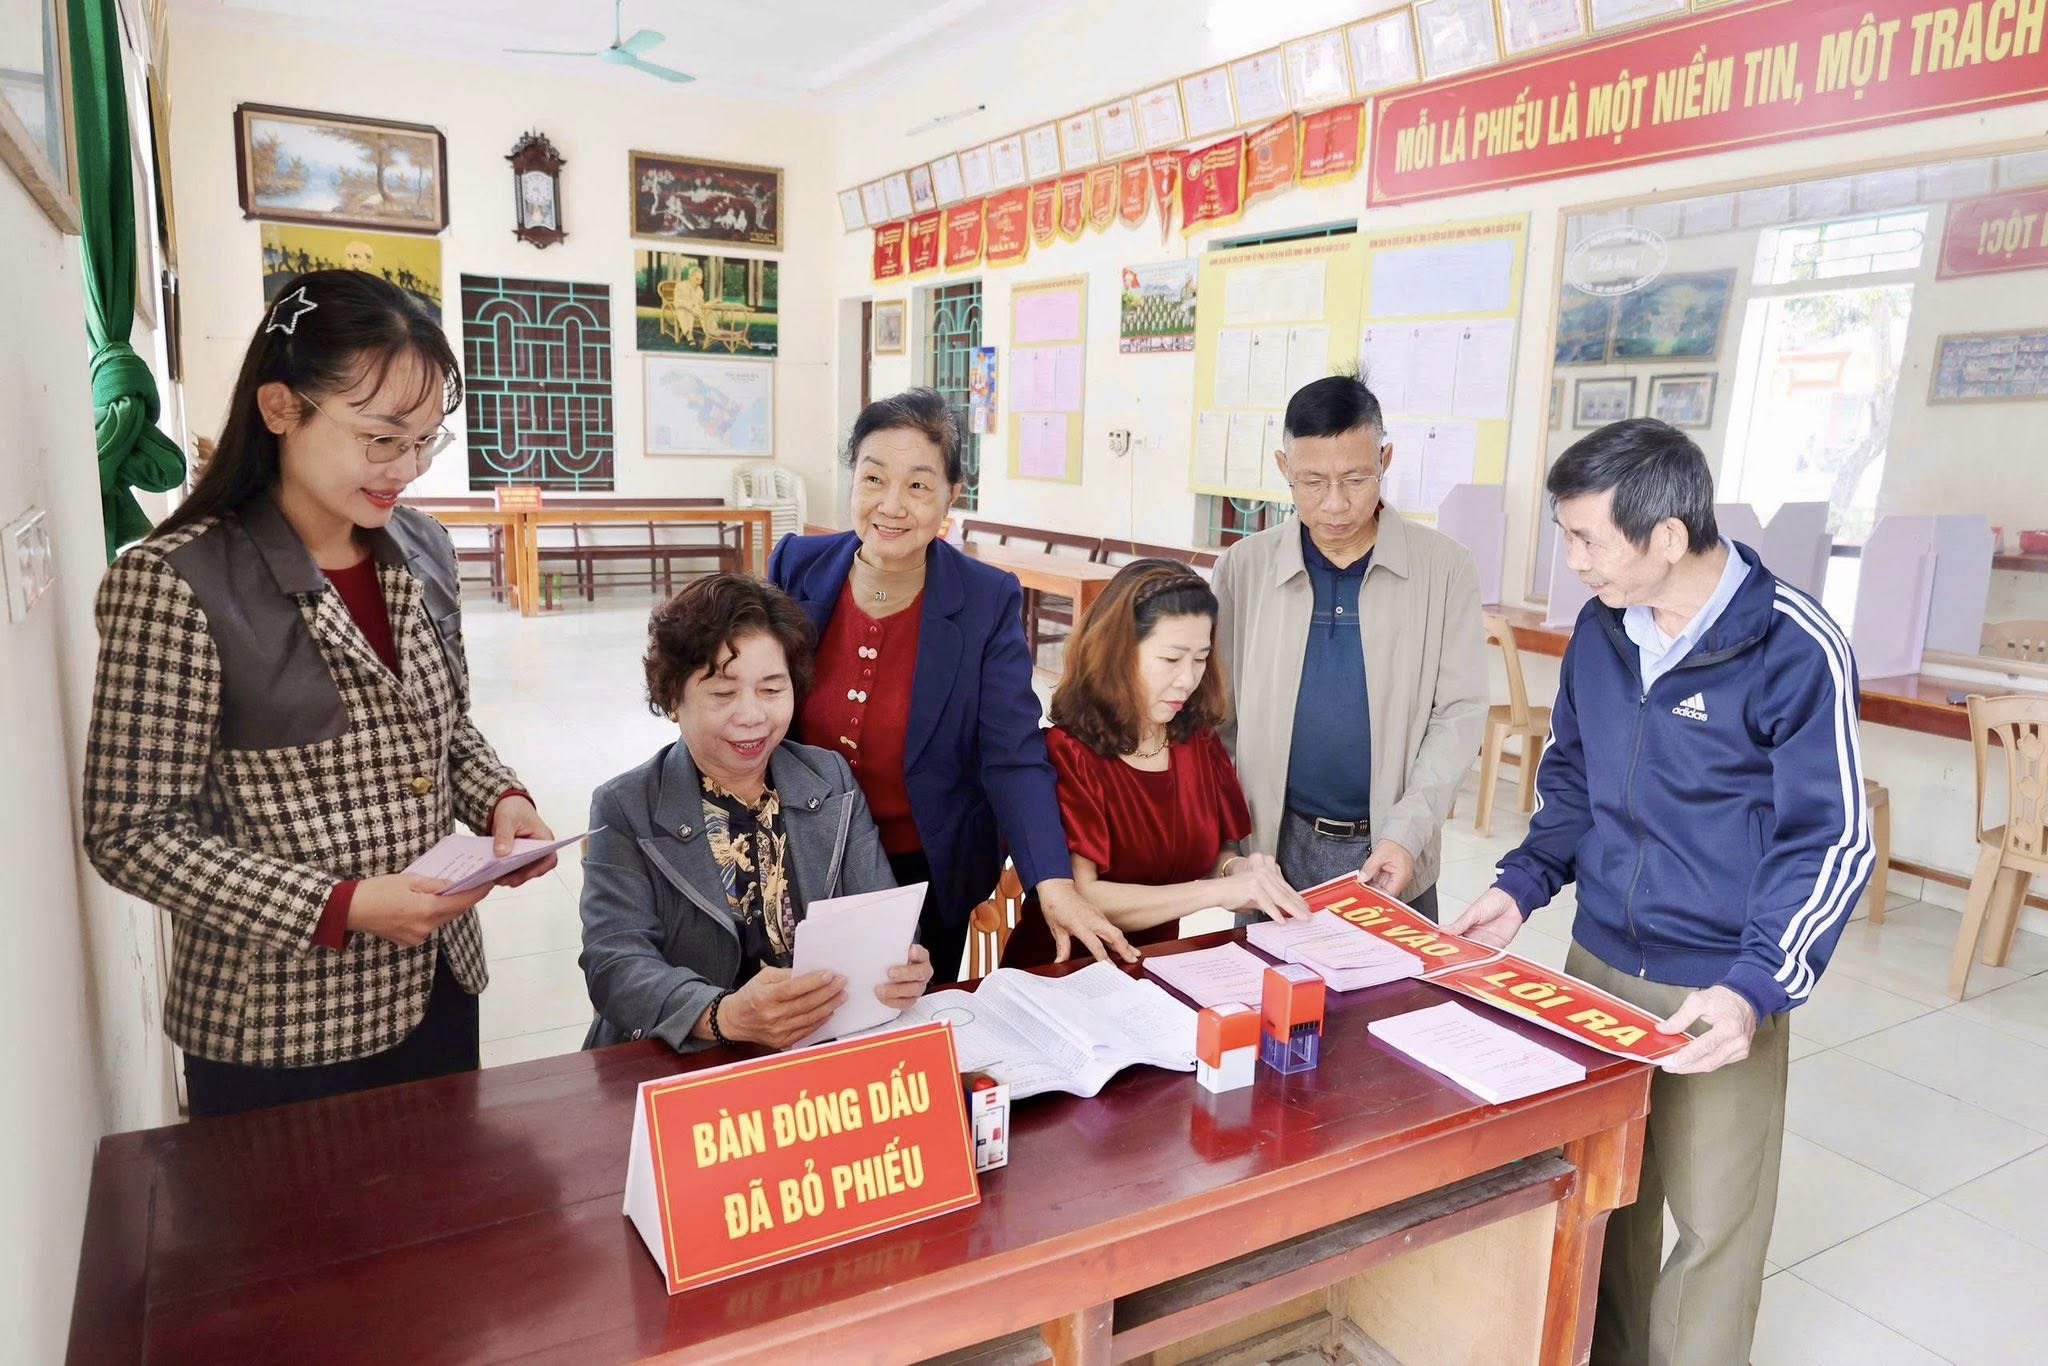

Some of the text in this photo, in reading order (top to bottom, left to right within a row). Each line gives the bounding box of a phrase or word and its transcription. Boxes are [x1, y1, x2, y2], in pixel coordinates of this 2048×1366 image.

[1394, 107, 1437, 174] MỖI
[1439, 106, 1467, 166] LÁ
[1471, 85, 1544, 160] PHIẾU
[1547, 81, 1579, 145] LÀ
[1585, 69, 1648, 145] MỘT
[1651, 45, 1735, 126] NIỀM
[1743, 41, 1804, 107] TIN,
[1815, 12, 1901, 100] MỘT
[1671, 706, 1708, 722] adidas
[1325, 896, 1395, 928] LỐI
[1381, 924, 1460, 957] VÀO
[1480, 970, 1649, 1048] LỐI RA
[692, 1060, 930, 1169] BÀN ĐÓNG DẤU
[724, 1136, 925, 1240] ĐÃ BỎ PHIẾU
